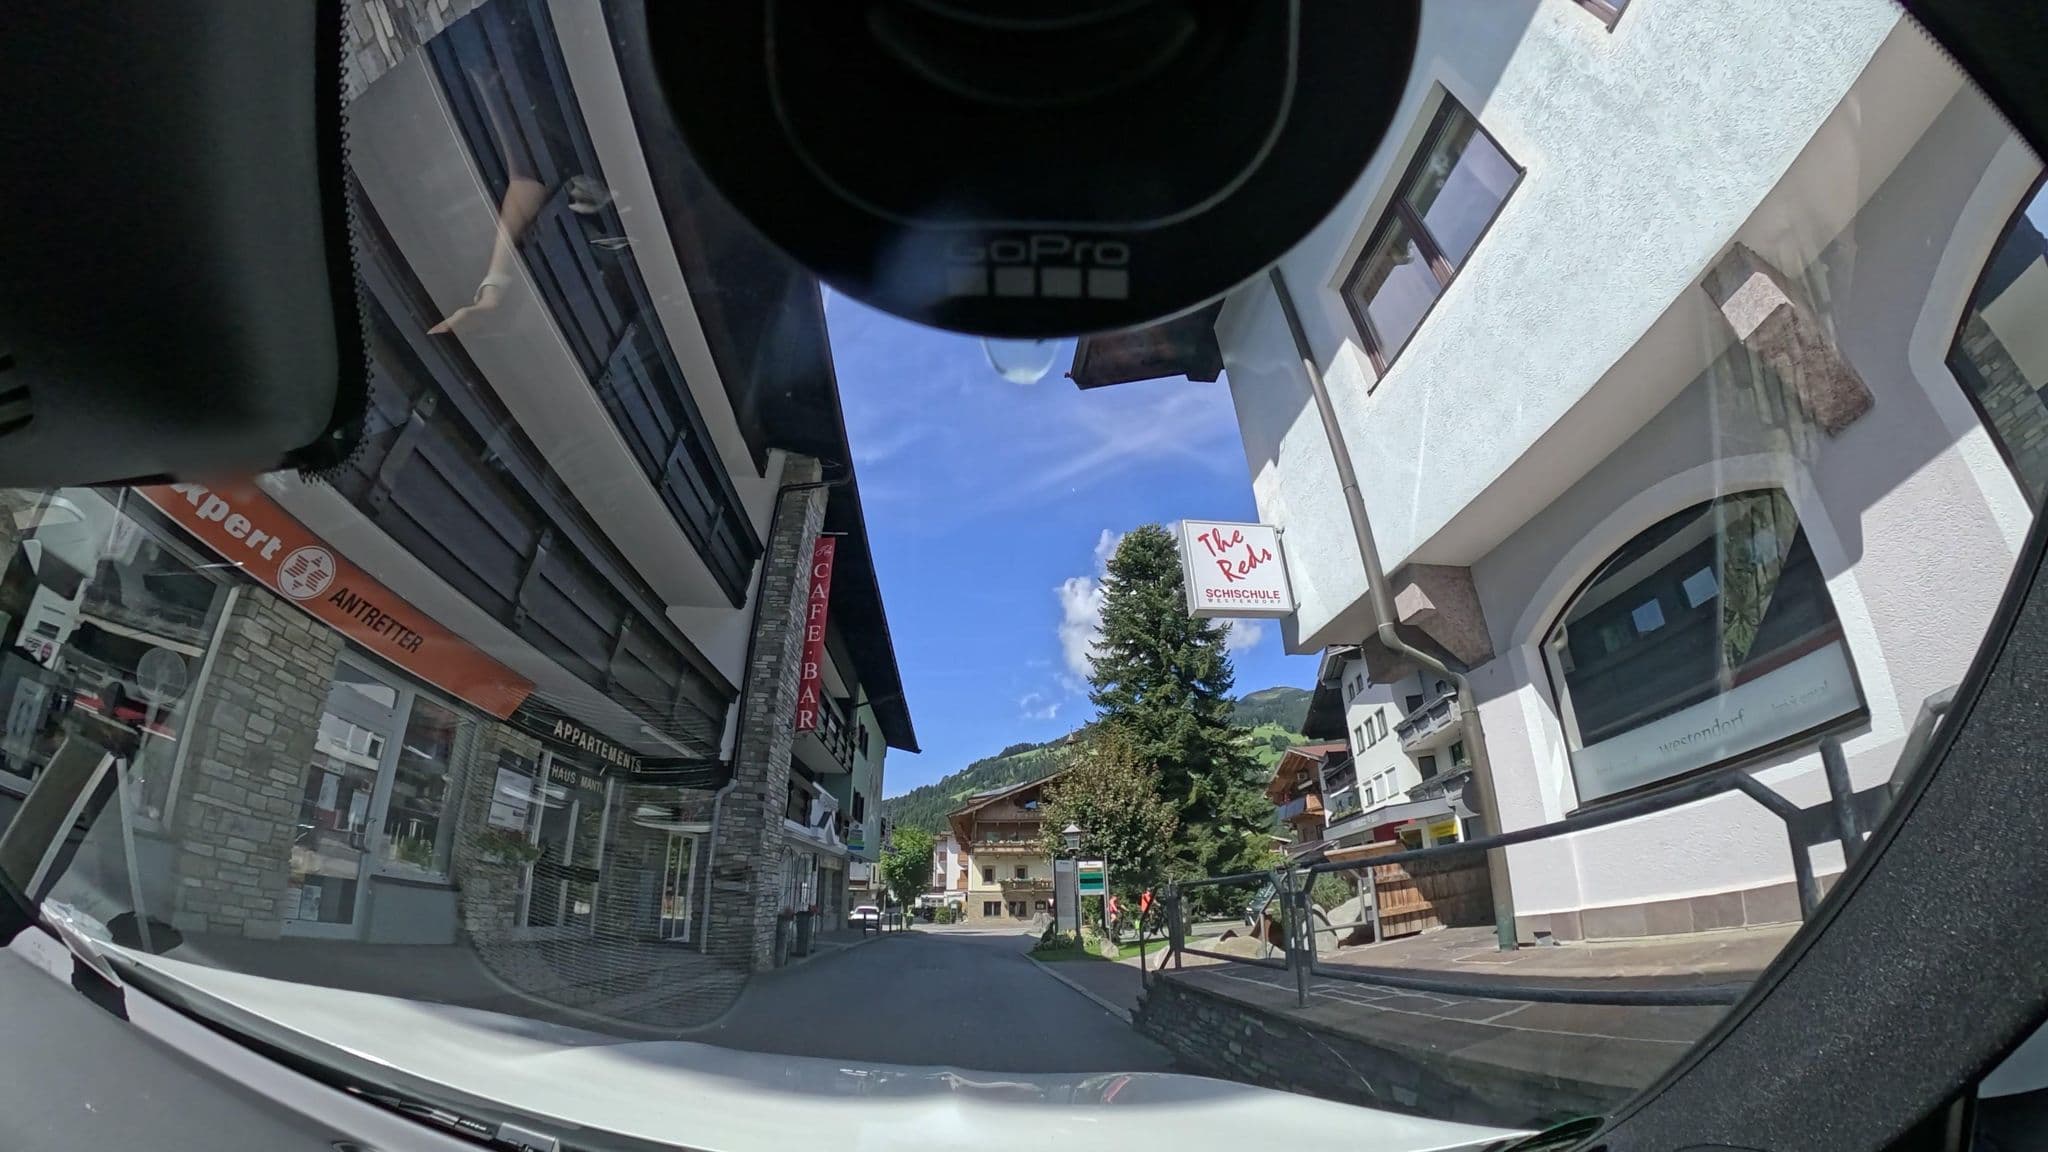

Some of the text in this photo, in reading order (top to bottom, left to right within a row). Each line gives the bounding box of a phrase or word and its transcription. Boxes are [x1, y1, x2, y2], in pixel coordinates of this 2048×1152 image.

[948, 233, 1129, 265] GoPro
[1198, 528, 1244, 557] The
[1216, 544, 1272, 583] Reds
[808, 562, 829, 642] CAFE
[1205, 588, 1281, 600] SCHISCHULE
[328, 587, 424, 654] ANTRETTER
[799, 662, 818, 729] BAR
[553, 719, 642, 774] APPARTEMENTS
[551, 764, 577, 784] HAUS
